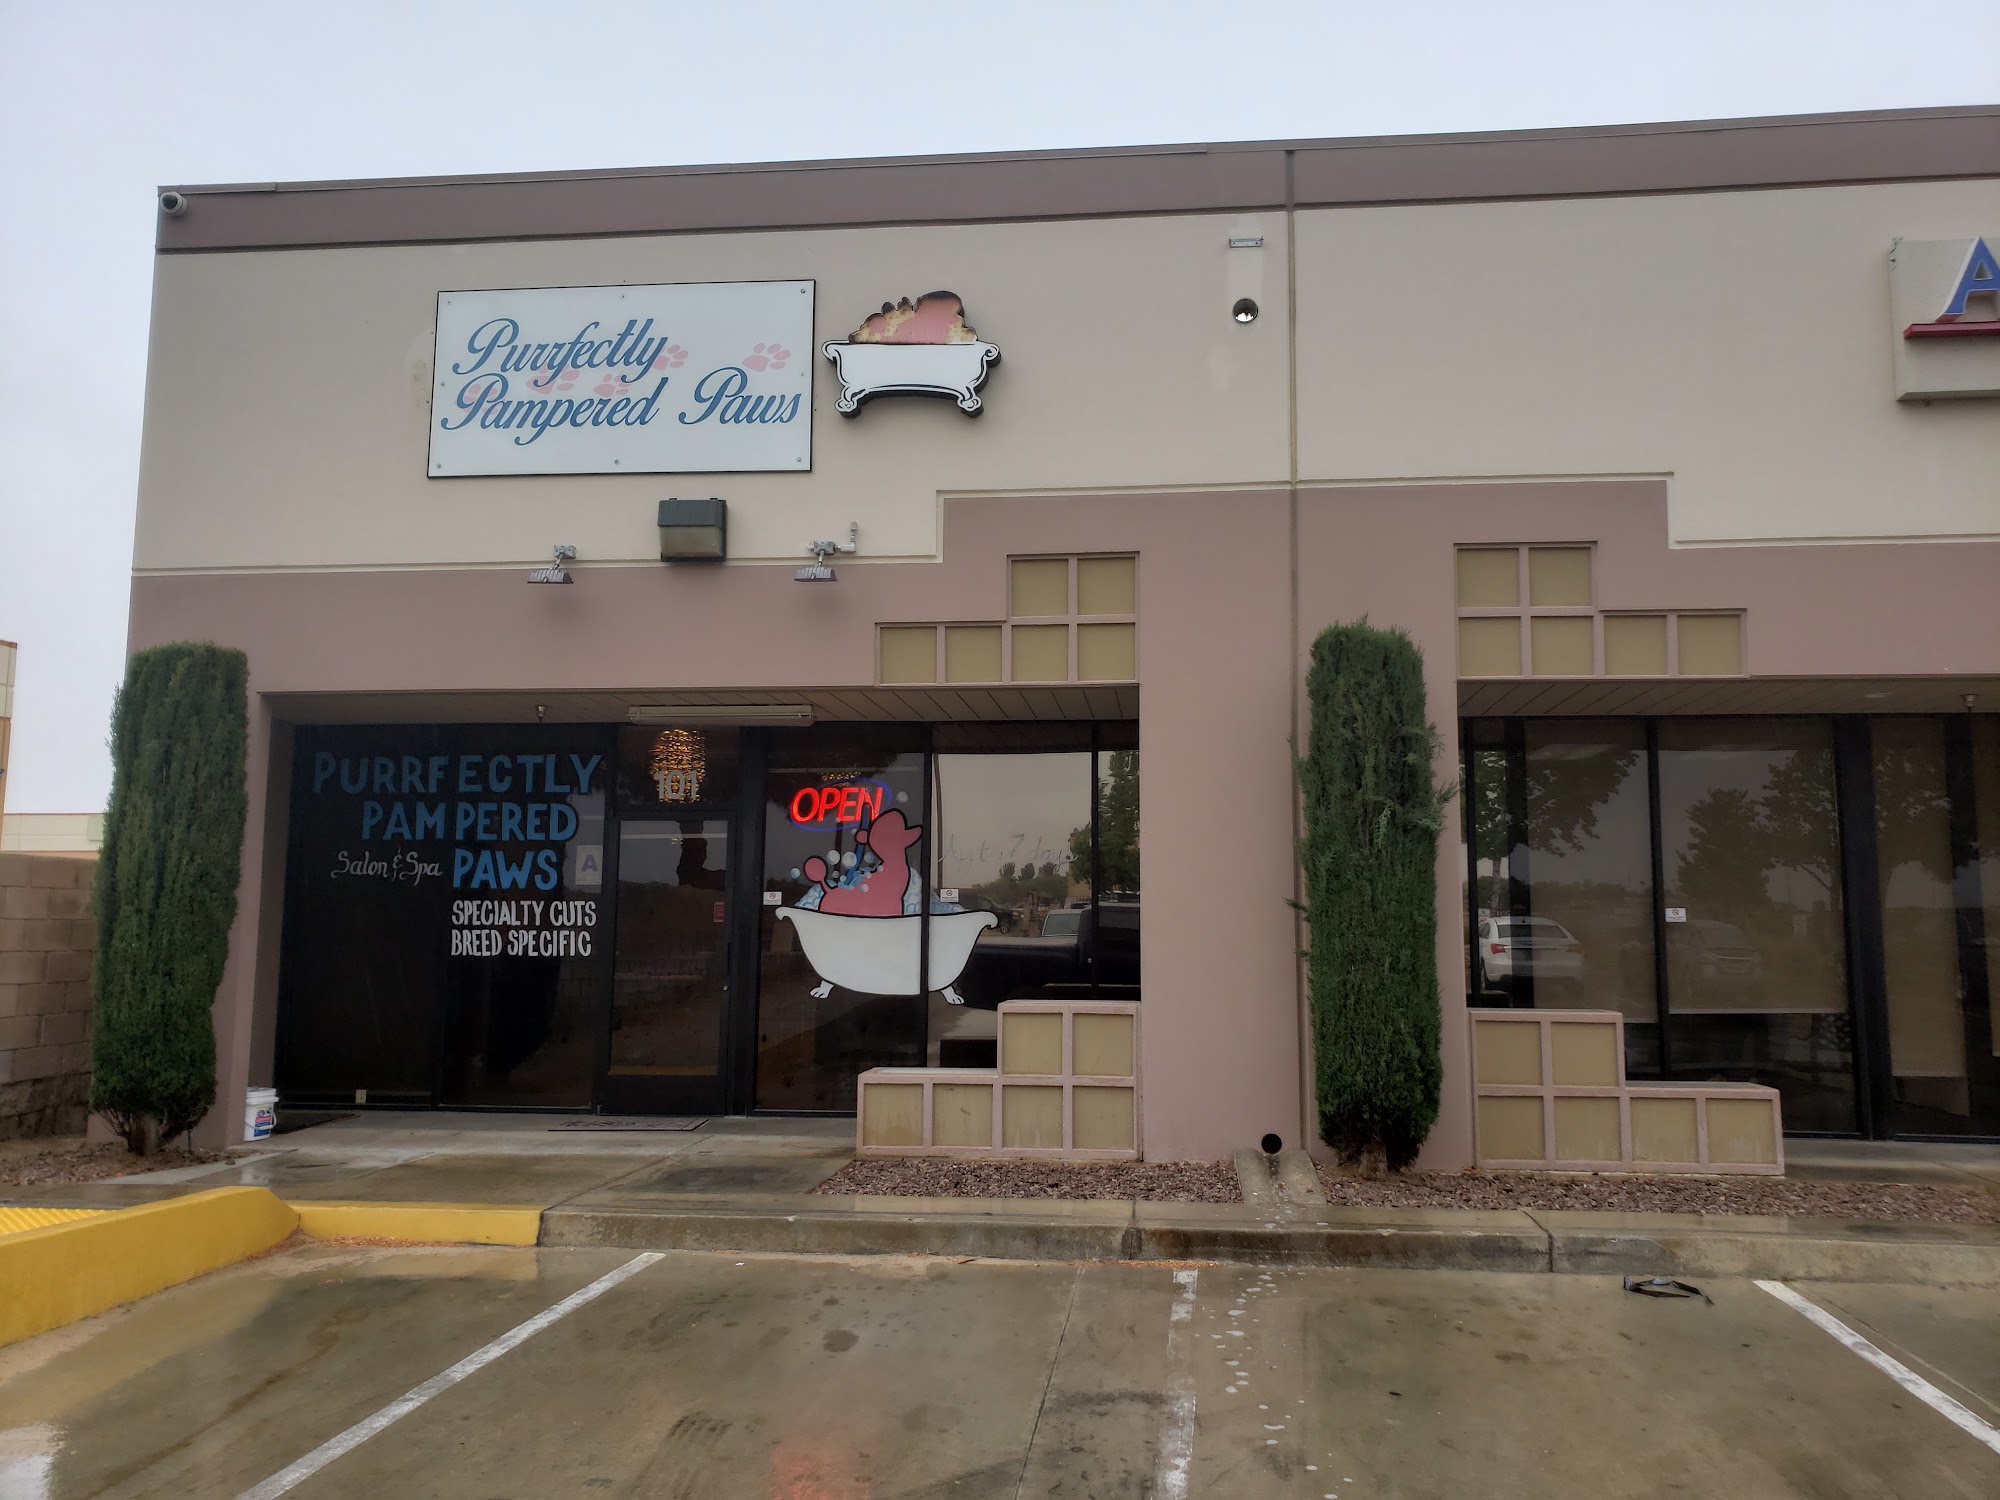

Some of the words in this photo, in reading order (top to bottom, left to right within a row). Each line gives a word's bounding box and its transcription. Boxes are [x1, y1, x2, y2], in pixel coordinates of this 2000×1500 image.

[452, 317, 669, 387] Purrfectly
[440, 372, 669, 446] Pampered
[678, 366, 802, 427] Paws
[312, 751, 603, 794] PURRFECTLY
[655, 769, 698, 800] 101
[361, 799, 577, 842] PAMPERED
[790, 786, 883, 825] OPEN
[580, 854, 599, 872] A
[1009, 833, 1025, 858] 7
[330, 850, 388, 879] Salon
[398, 851, 444, 886] Spa
[453, 847, 558, 891] PAWS
[451, 899, 545, 926] SPECIALTY
[549, 900, 597, 927] CUTS
[450, 929, 503, 956] BREED
[507, 929, 592, 957] SPECIFIC
